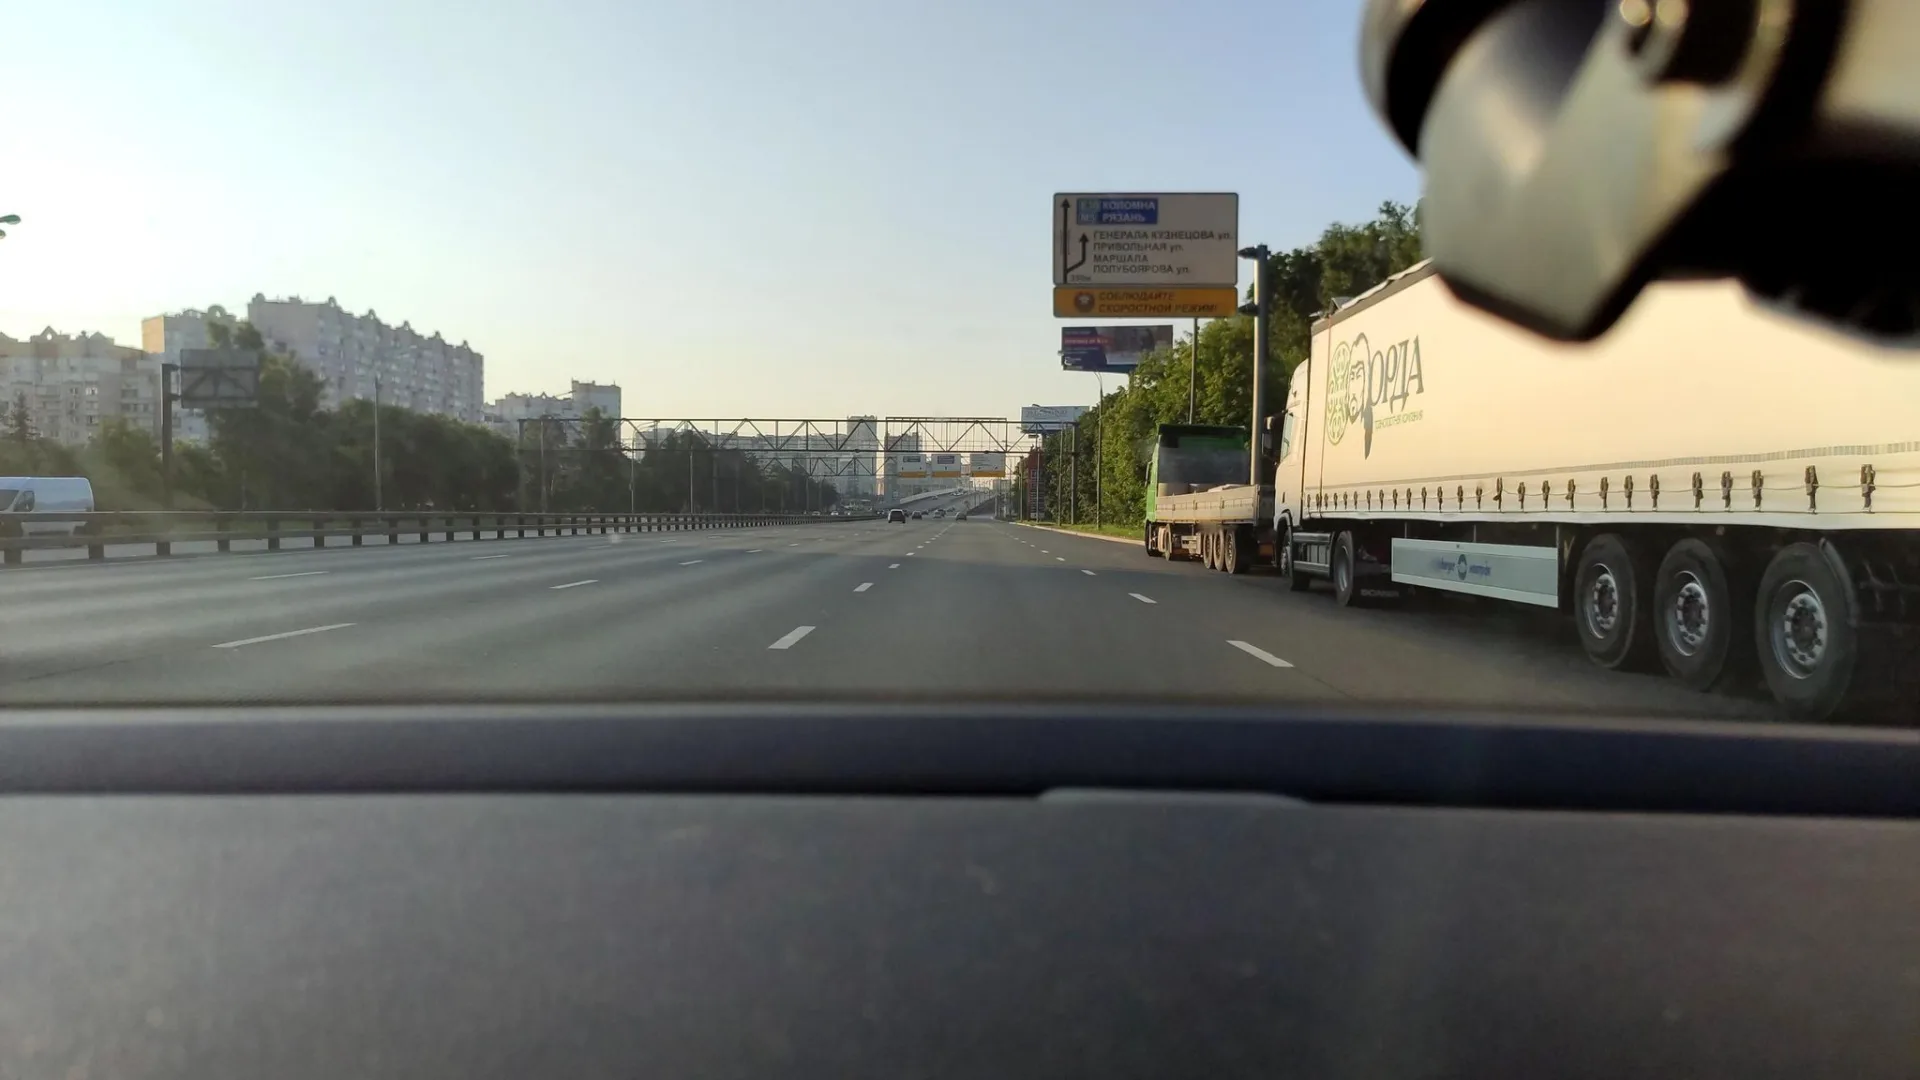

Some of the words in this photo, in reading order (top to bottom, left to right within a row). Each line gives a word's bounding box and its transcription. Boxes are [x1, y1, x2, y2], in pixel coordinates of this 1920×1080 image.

[1102, 201, 1156, 210] КОЛОМНА
[1102, 213, 1145, 222] РЯЗАНЬ
[1093, 231, 1148, 240] ГЕНЕРАЛА
[1151, 230, 1215, 241] КУЗНЕЦОВА
[1093, 242, 1168, 251] ПРИВОЛЬНАЯ
[1093, 254, 1148, 262] МАРШАЛА
[1093, 264, 1173, 273] ПОЛУБОЯРОВА
[1099, 303, 1172, 313] СКОРОСТНОЙ
